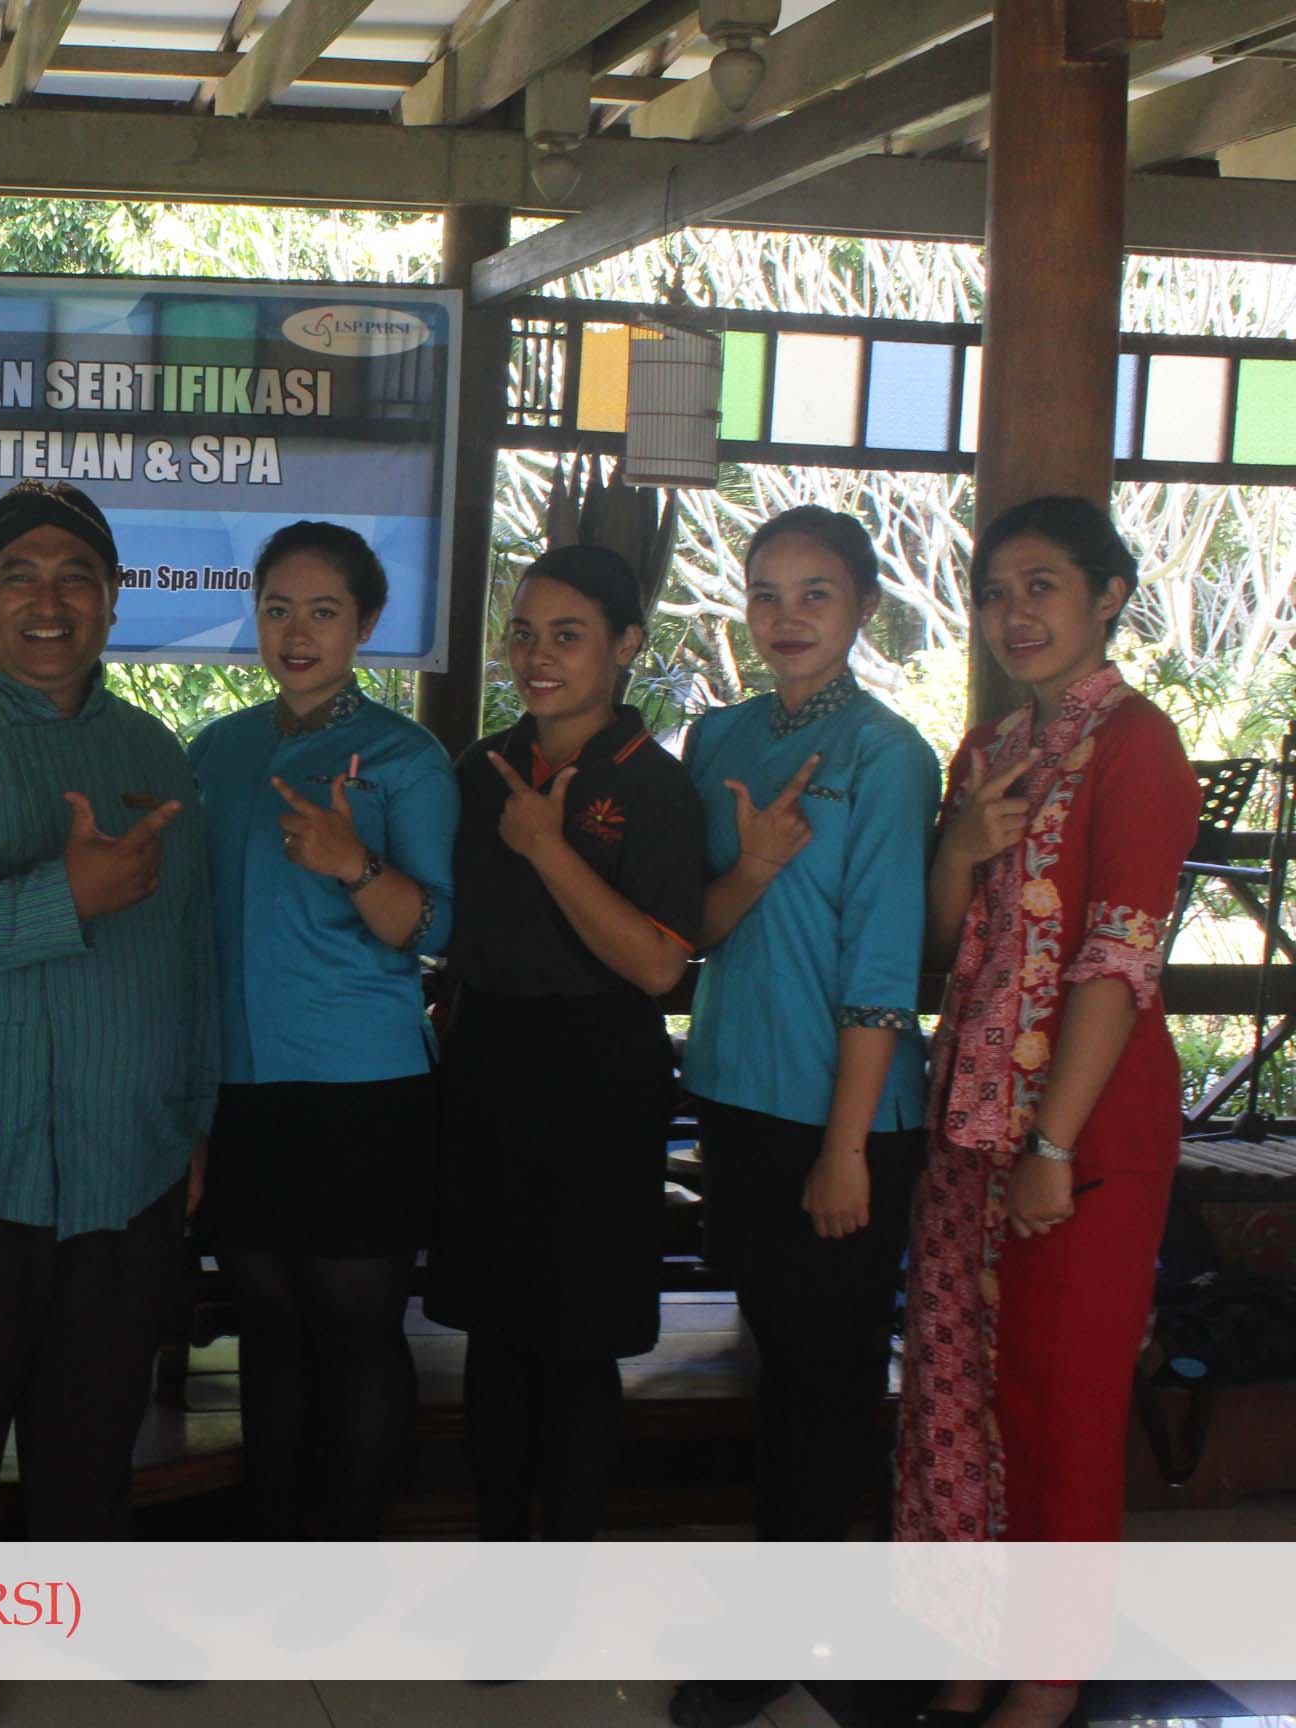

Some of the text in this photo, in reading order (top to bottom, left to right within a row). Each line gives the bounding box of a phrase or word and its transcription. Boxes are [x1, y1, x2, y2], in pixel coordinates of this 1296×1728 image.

[45, 362, 334, 417] SERTIFIKASI
[144, 438, 181, 483] &
[190, 434, 282, 485] SPA
[157, 564, 199, 592] Spa
[204, 565, 255, 591] Indo
